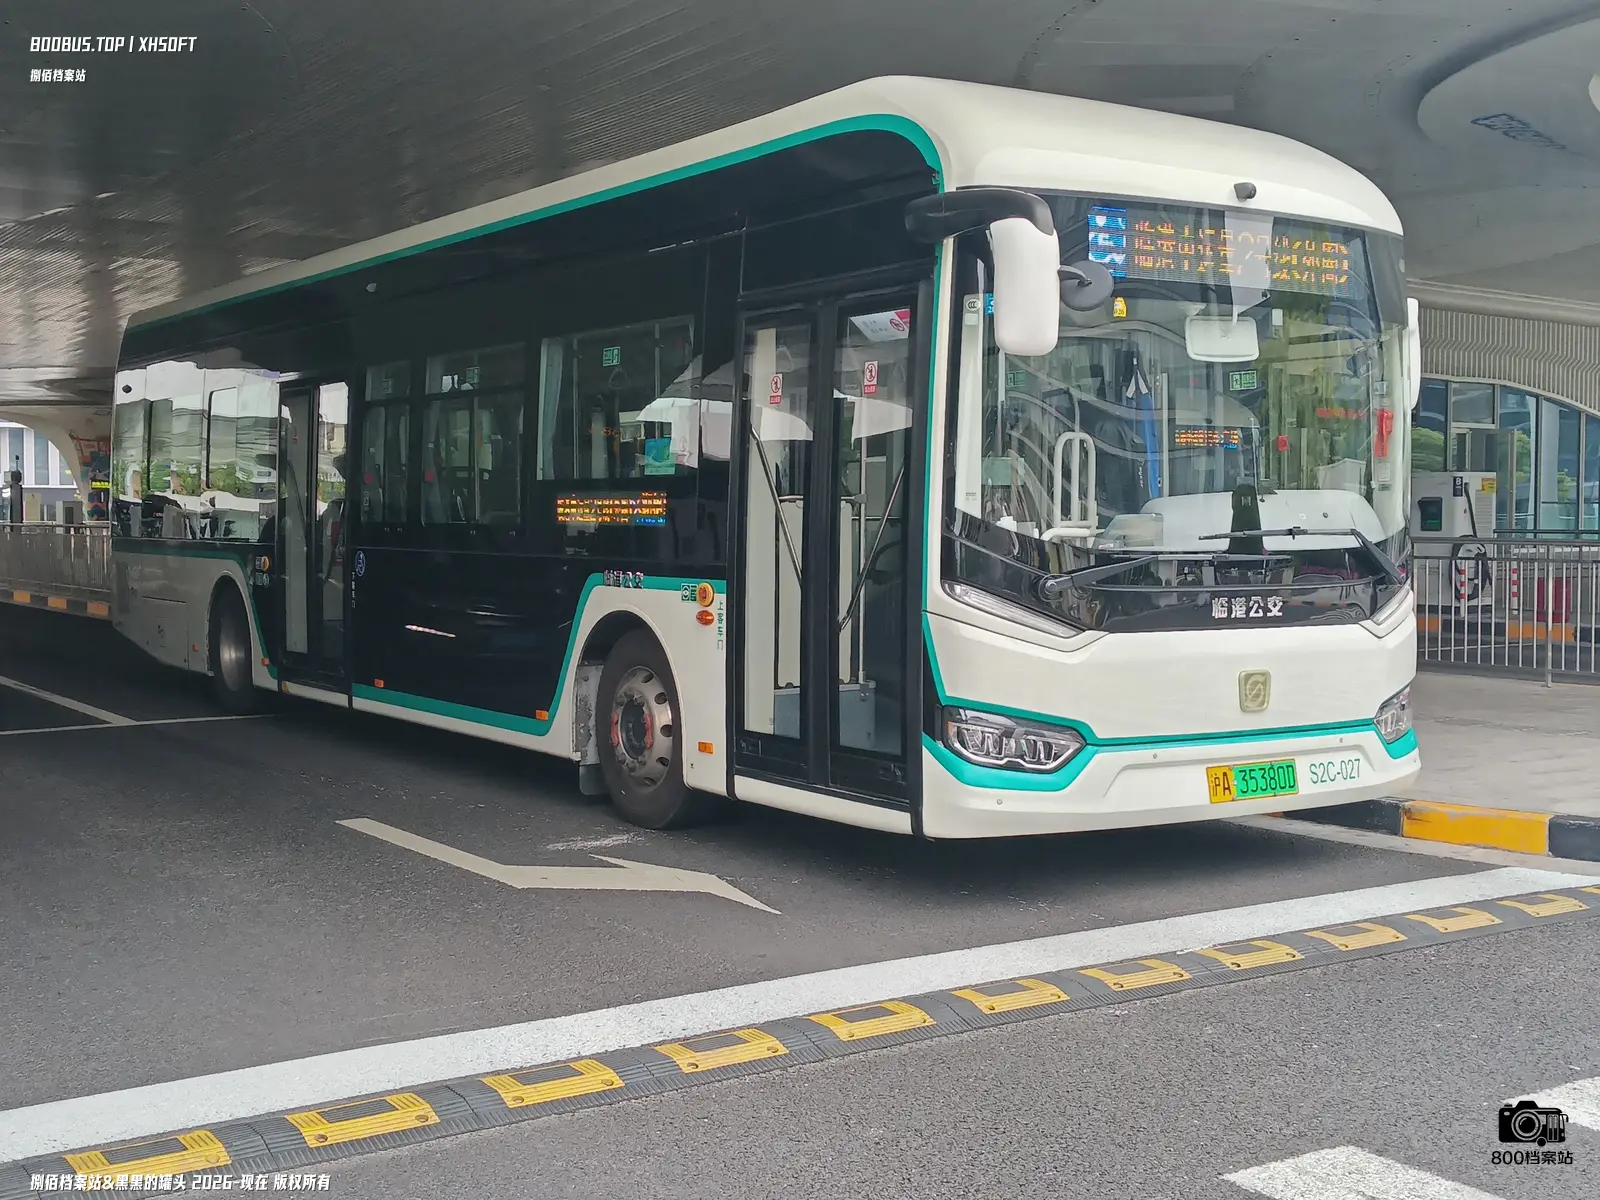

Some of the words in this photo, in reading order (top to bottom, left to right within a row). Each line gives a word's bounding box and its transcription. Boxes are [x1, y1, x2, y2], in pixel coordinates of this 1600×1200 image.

[1212, 596, 1283, 618] 临港公交
[1309, 758, 1361, 784] S2C-027
